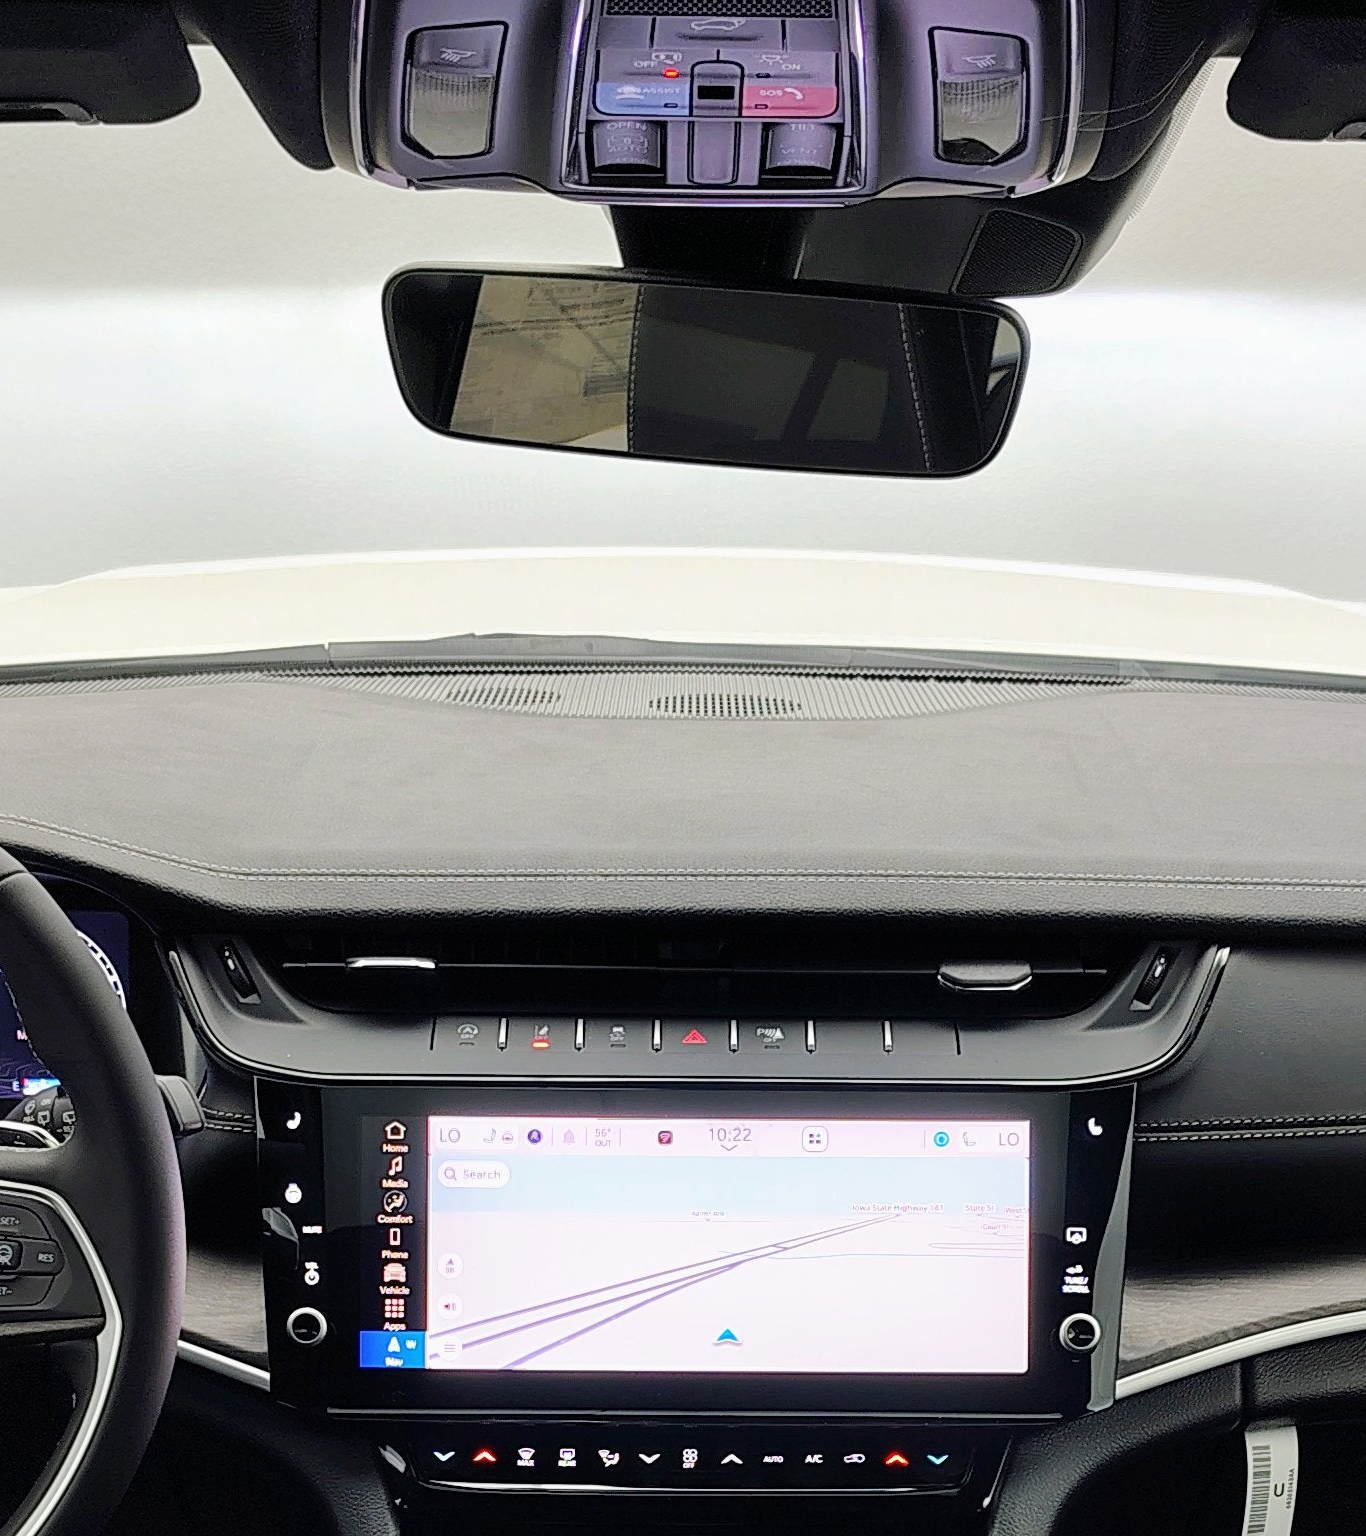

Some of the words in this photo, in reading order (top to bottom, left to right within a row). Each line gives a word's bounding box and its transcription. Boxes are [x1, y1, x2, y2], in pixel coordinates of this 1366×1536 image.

[634, 60, 655, 68] OFF
[782, 63, 801, 71] ON
[643, 87, 680, 95] ASSIST
[760, 89, 783, 97] SOS
[607, 122, 647, 130] OPEN
[439, 1128, 461, 1143] LO
[709, 1127, 752, 1142] 10:22
[998, 1132, 1020, 1147] LO
[595, 1139, 612, 1147] OUT
[383, 1144, 409, 1153] Home
[463, 1168, 501, 1180] Search
[852, 1204, 871, 1212] Iowa
[871, 1203, 893, 1212] State
[893, 1204, 928, 1214] Highway
[965, 1204, 983, 1212] State
[0, 1216, 20, 1226] SET+
[377, 1214, 414, 1225] Comfort
[37, 1252, 55, 1263] RES
[381, 1250, 409, 1260] Phone
[379, 1285, 410, 1295] Vehicle
[383, 1321, 407, 1332] Apps
[517, 1459, 535, 1467] MAX
[763, 1455, 784, 1464] AUTO
[805, 1454, 824, 1464] A/C
[1274, 1483, 1285, 1497] U
